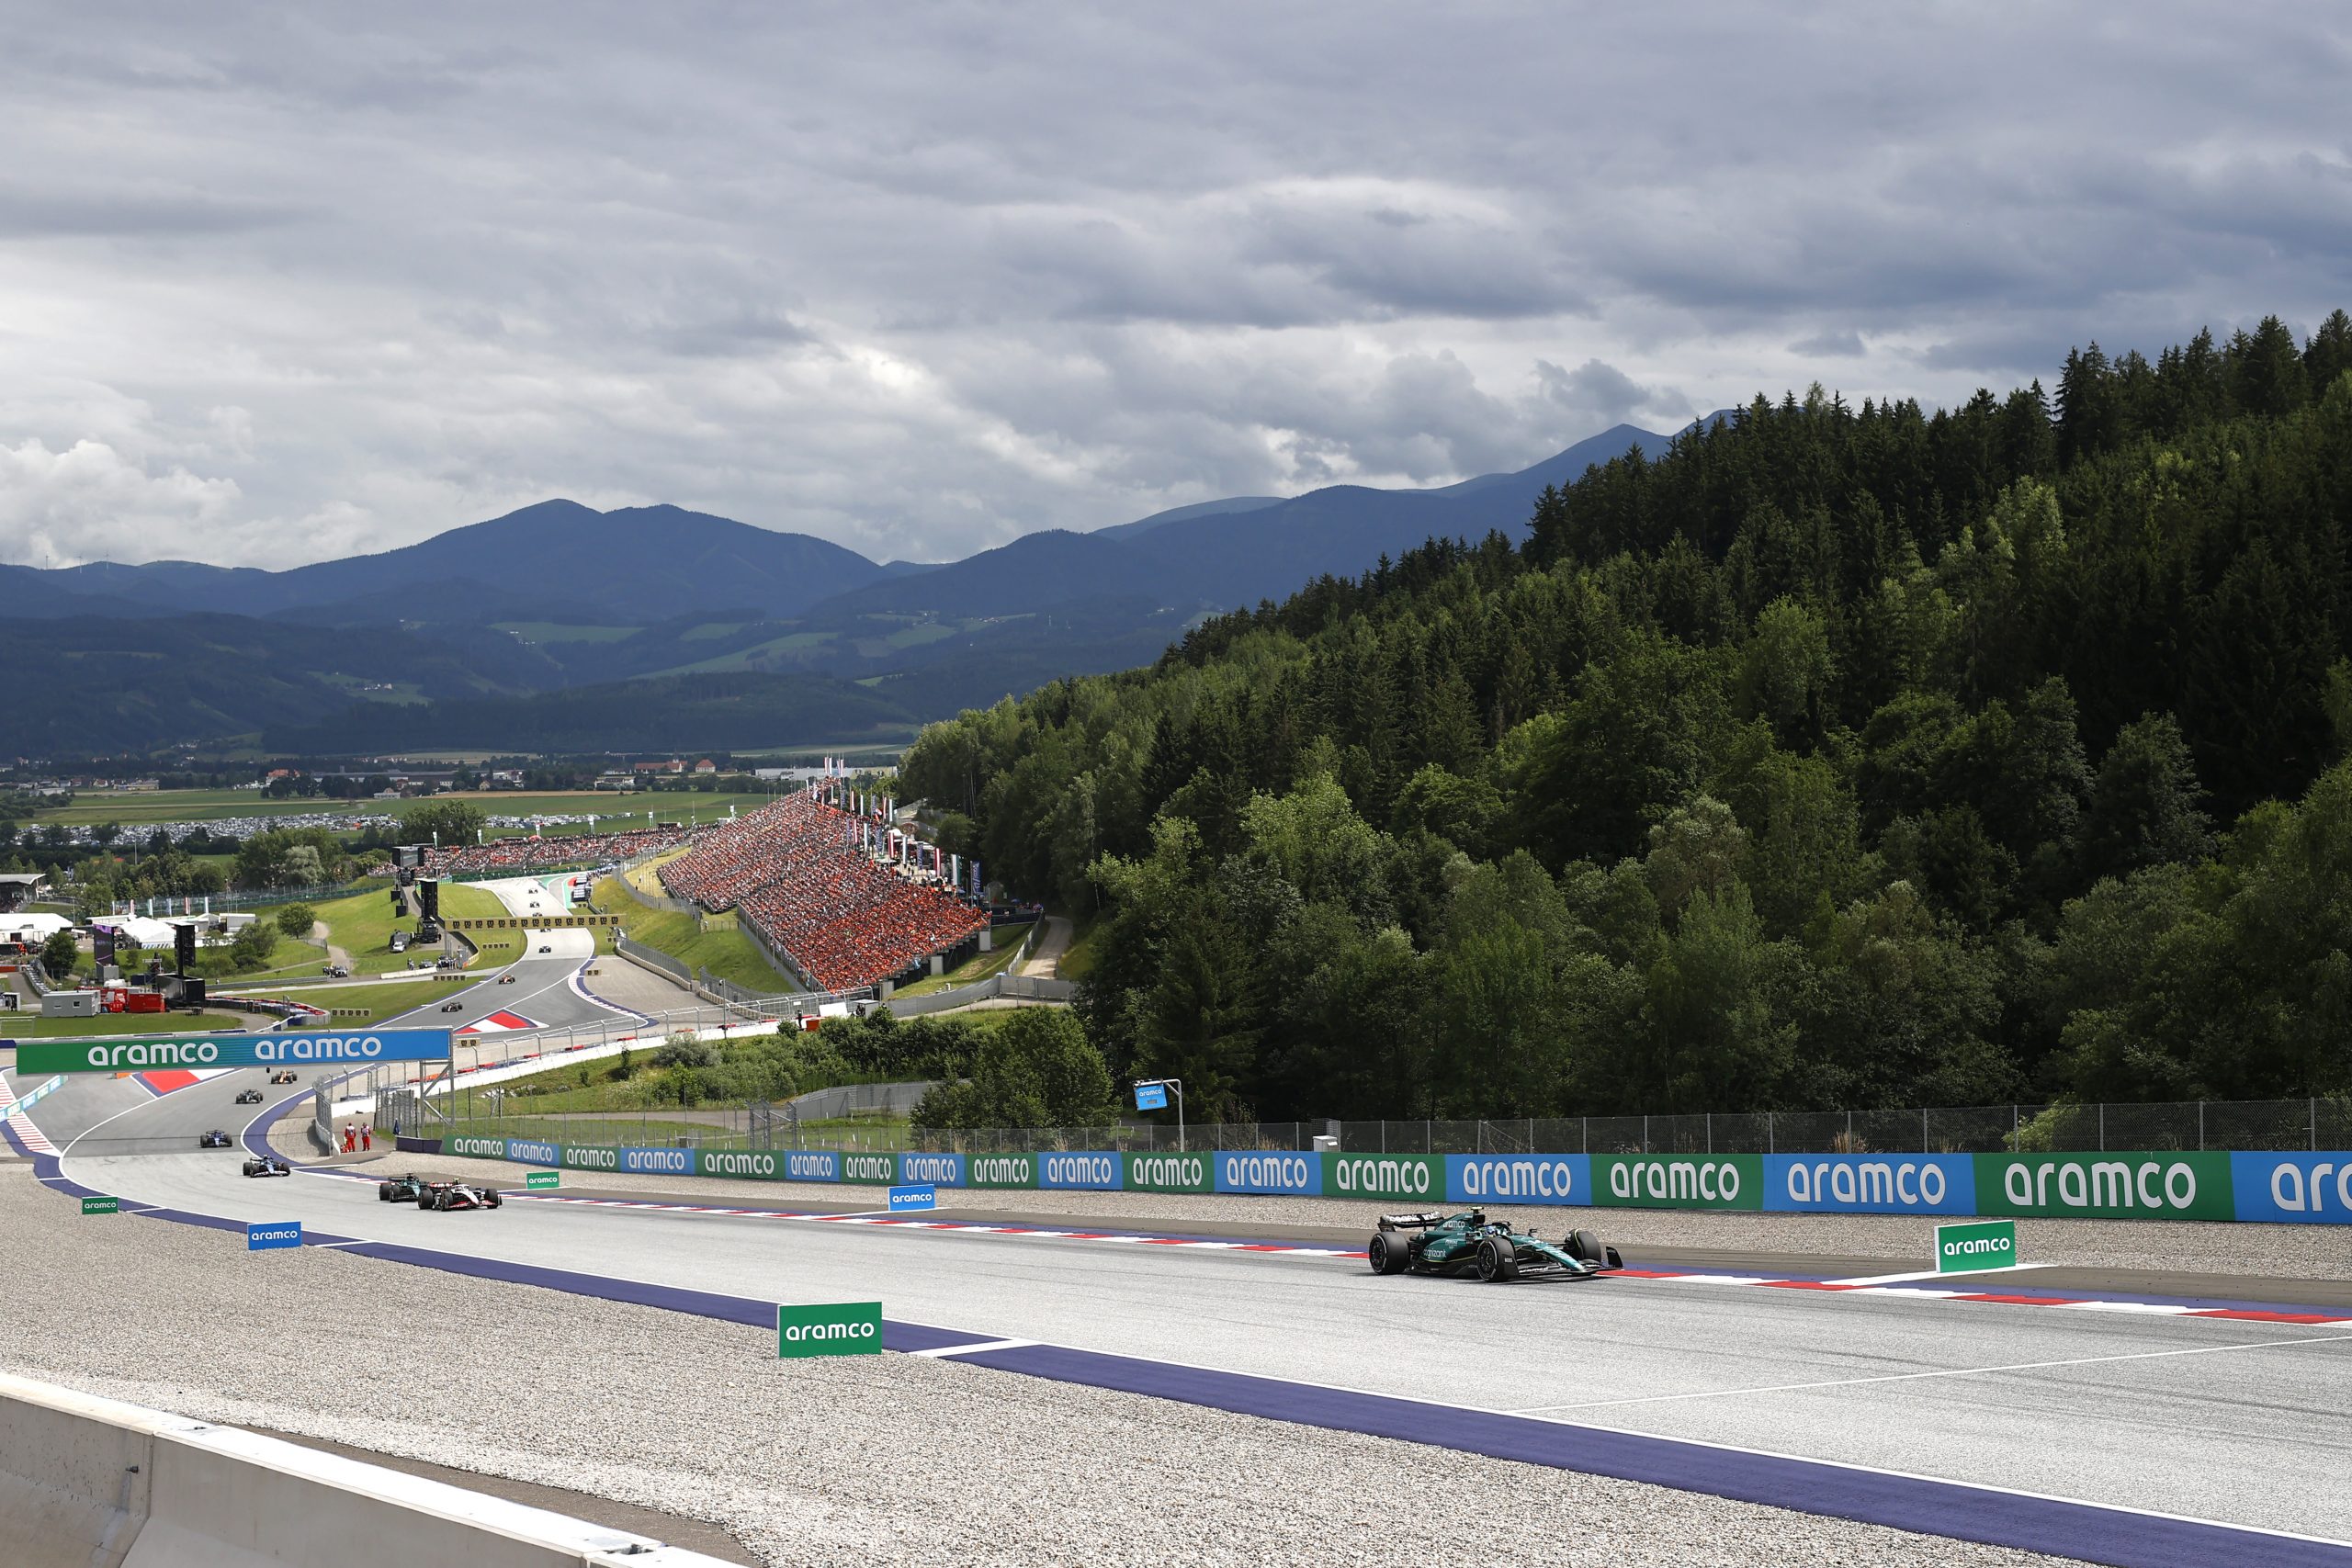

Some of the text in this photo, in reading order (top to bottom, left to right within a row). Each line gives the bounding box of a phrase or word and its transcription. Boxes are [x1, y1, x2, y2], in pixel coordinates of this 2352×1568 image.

[87, 1037, 382, 1066] aramco aramco
[455, 1138, 503, 1155] aramco
[511, 1143, 553, 1162] aramco
[566, 1147, 616, 1168] aramco
[628, 1151, 685, 1170] aramco
[705, 1153, 775, 1174] aramco
[791, 1155, 832, 1177] aramco
[846, 1156, 892, 1179] aramco
[906, 1157, 956, 1182] aramco
[974, 1157, 1029, 1183] aramco
[1047, 1157, 1112, 1184] aramco
[1133, 1157, 1203, 1186] aramco
[1227, 1157, 1307, 1188] aramco
[1336, 1158, 1430, 1193] aramco
[1463, 1161, 1572, 1197] aramco
[1610, 1162, 1740, 1201] aramco
[1788, 1162, 1946, 1205] aramco
[2005, 1162, 2197, 1209] aramco
[892, 1193, 933, 1202] aramco
[251, 1230, 298, 1241] aramco
[1943, 1236, 2011, 1256] aramco
[786, 1322, 875, 1341] aramco
